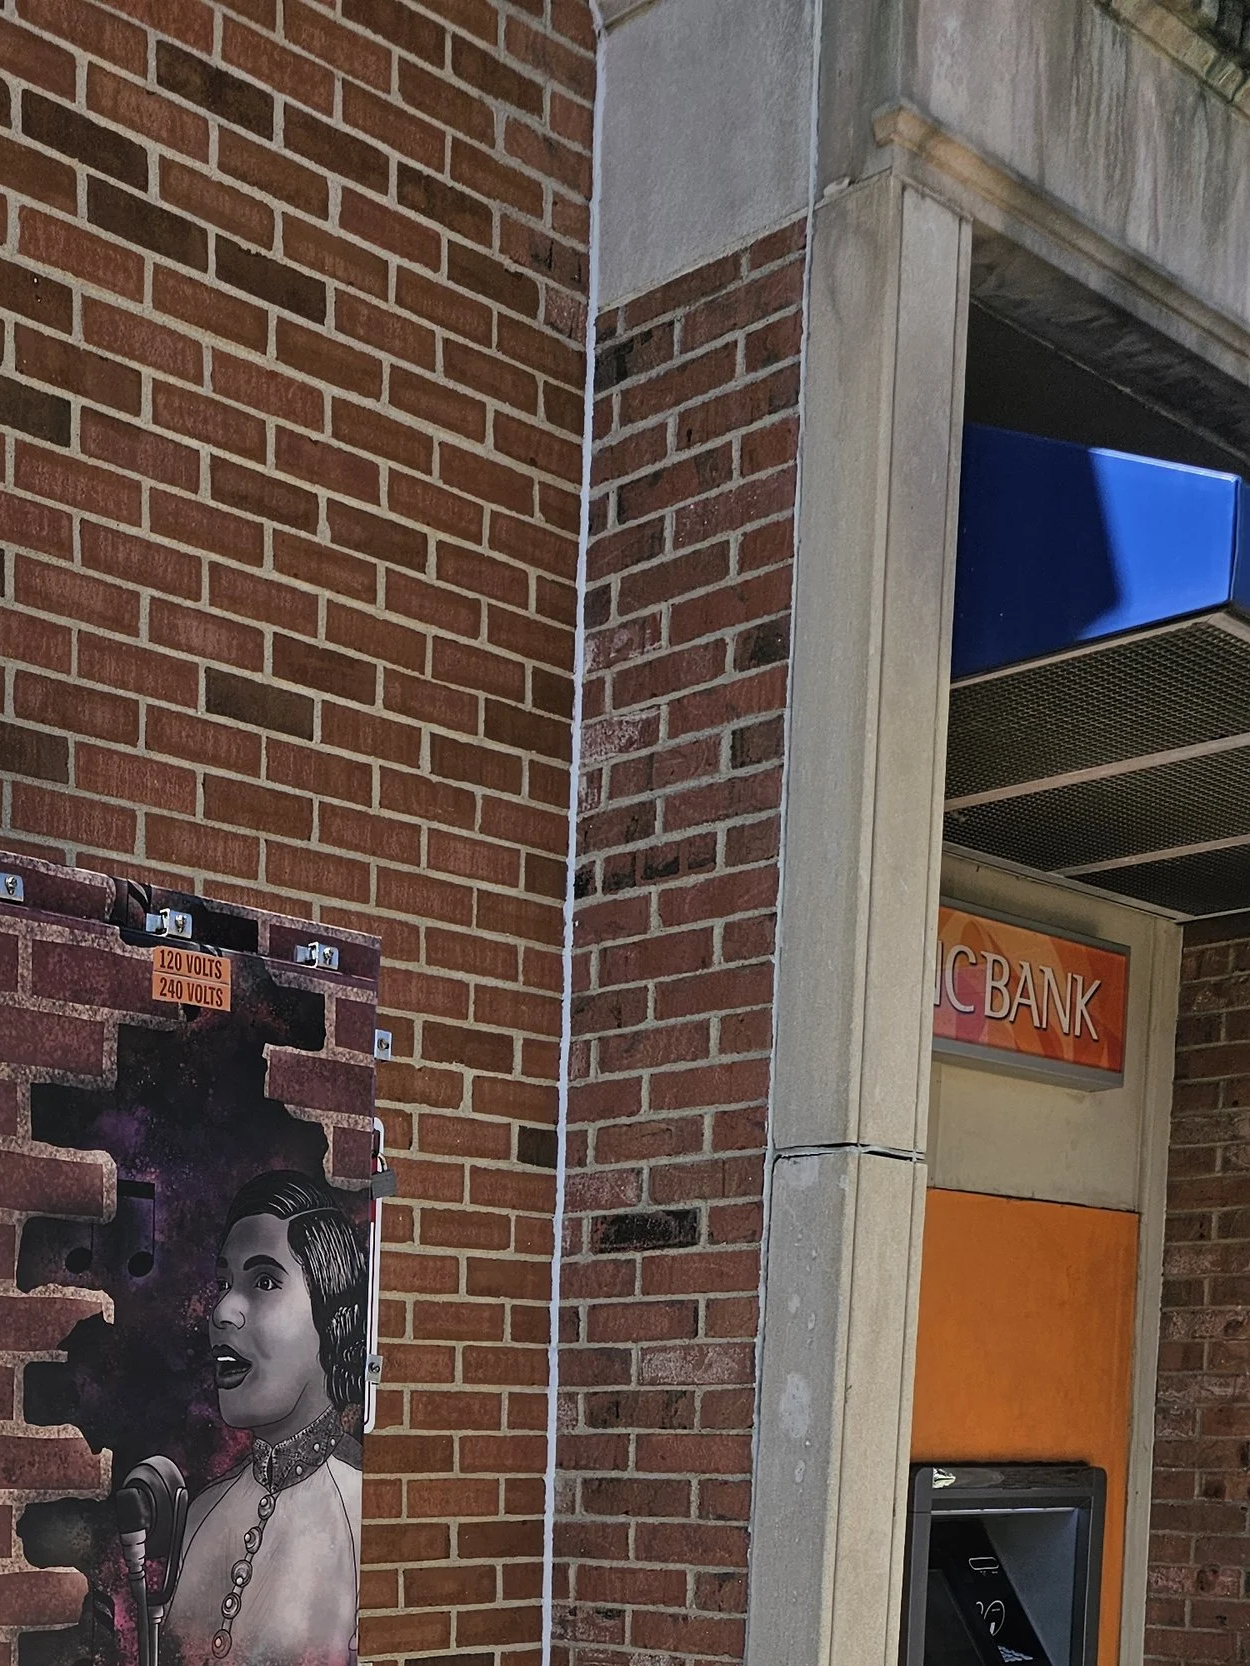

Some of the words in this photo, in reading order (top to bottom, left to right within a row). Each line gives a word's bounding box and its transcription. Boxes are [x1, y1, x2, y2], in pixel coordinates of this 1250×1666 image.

[160, 949, 182, 972] 120
[186, 953, 222, 979] VOLTS
[159, 977, 183, 1000] 240
[187, 982, 223, 1008] VOLTS
